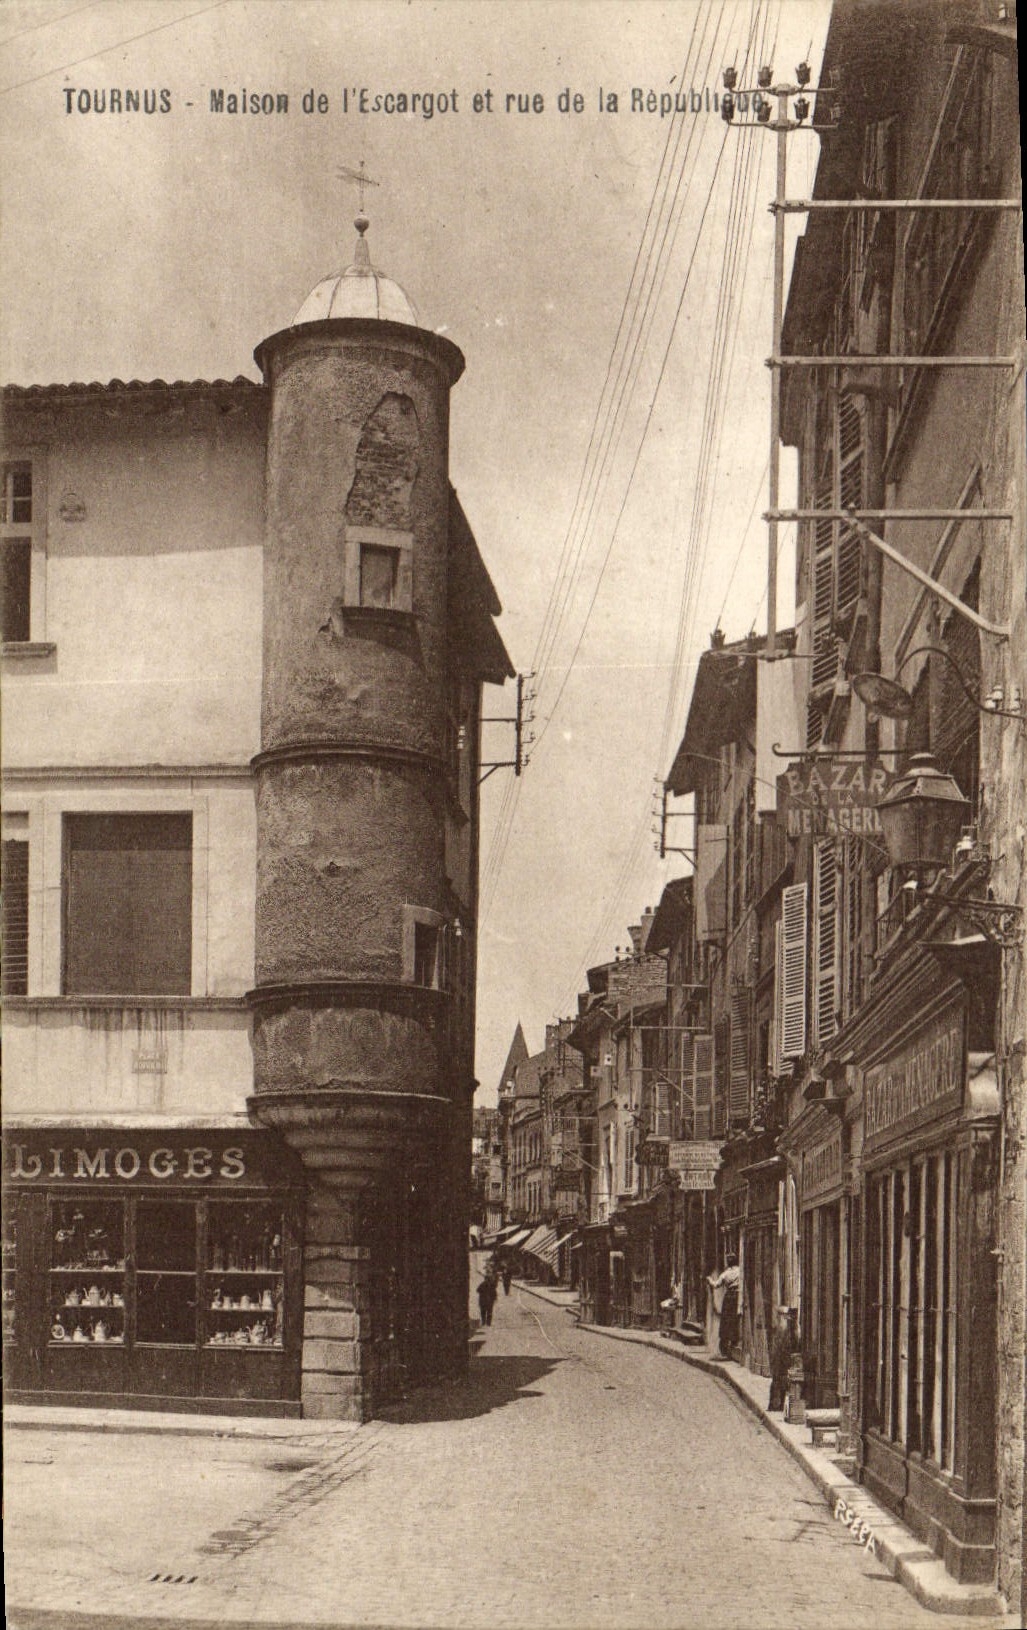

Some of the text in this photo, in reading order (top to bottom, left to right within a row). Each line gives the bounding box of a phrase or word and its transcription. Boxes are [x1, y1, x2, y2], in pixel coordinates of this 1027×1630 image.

[785, 766, 886, 796] BAZAR
[838, 791, 854, 804] LA
[10, 1143, 246, 1179] LIMOGES
